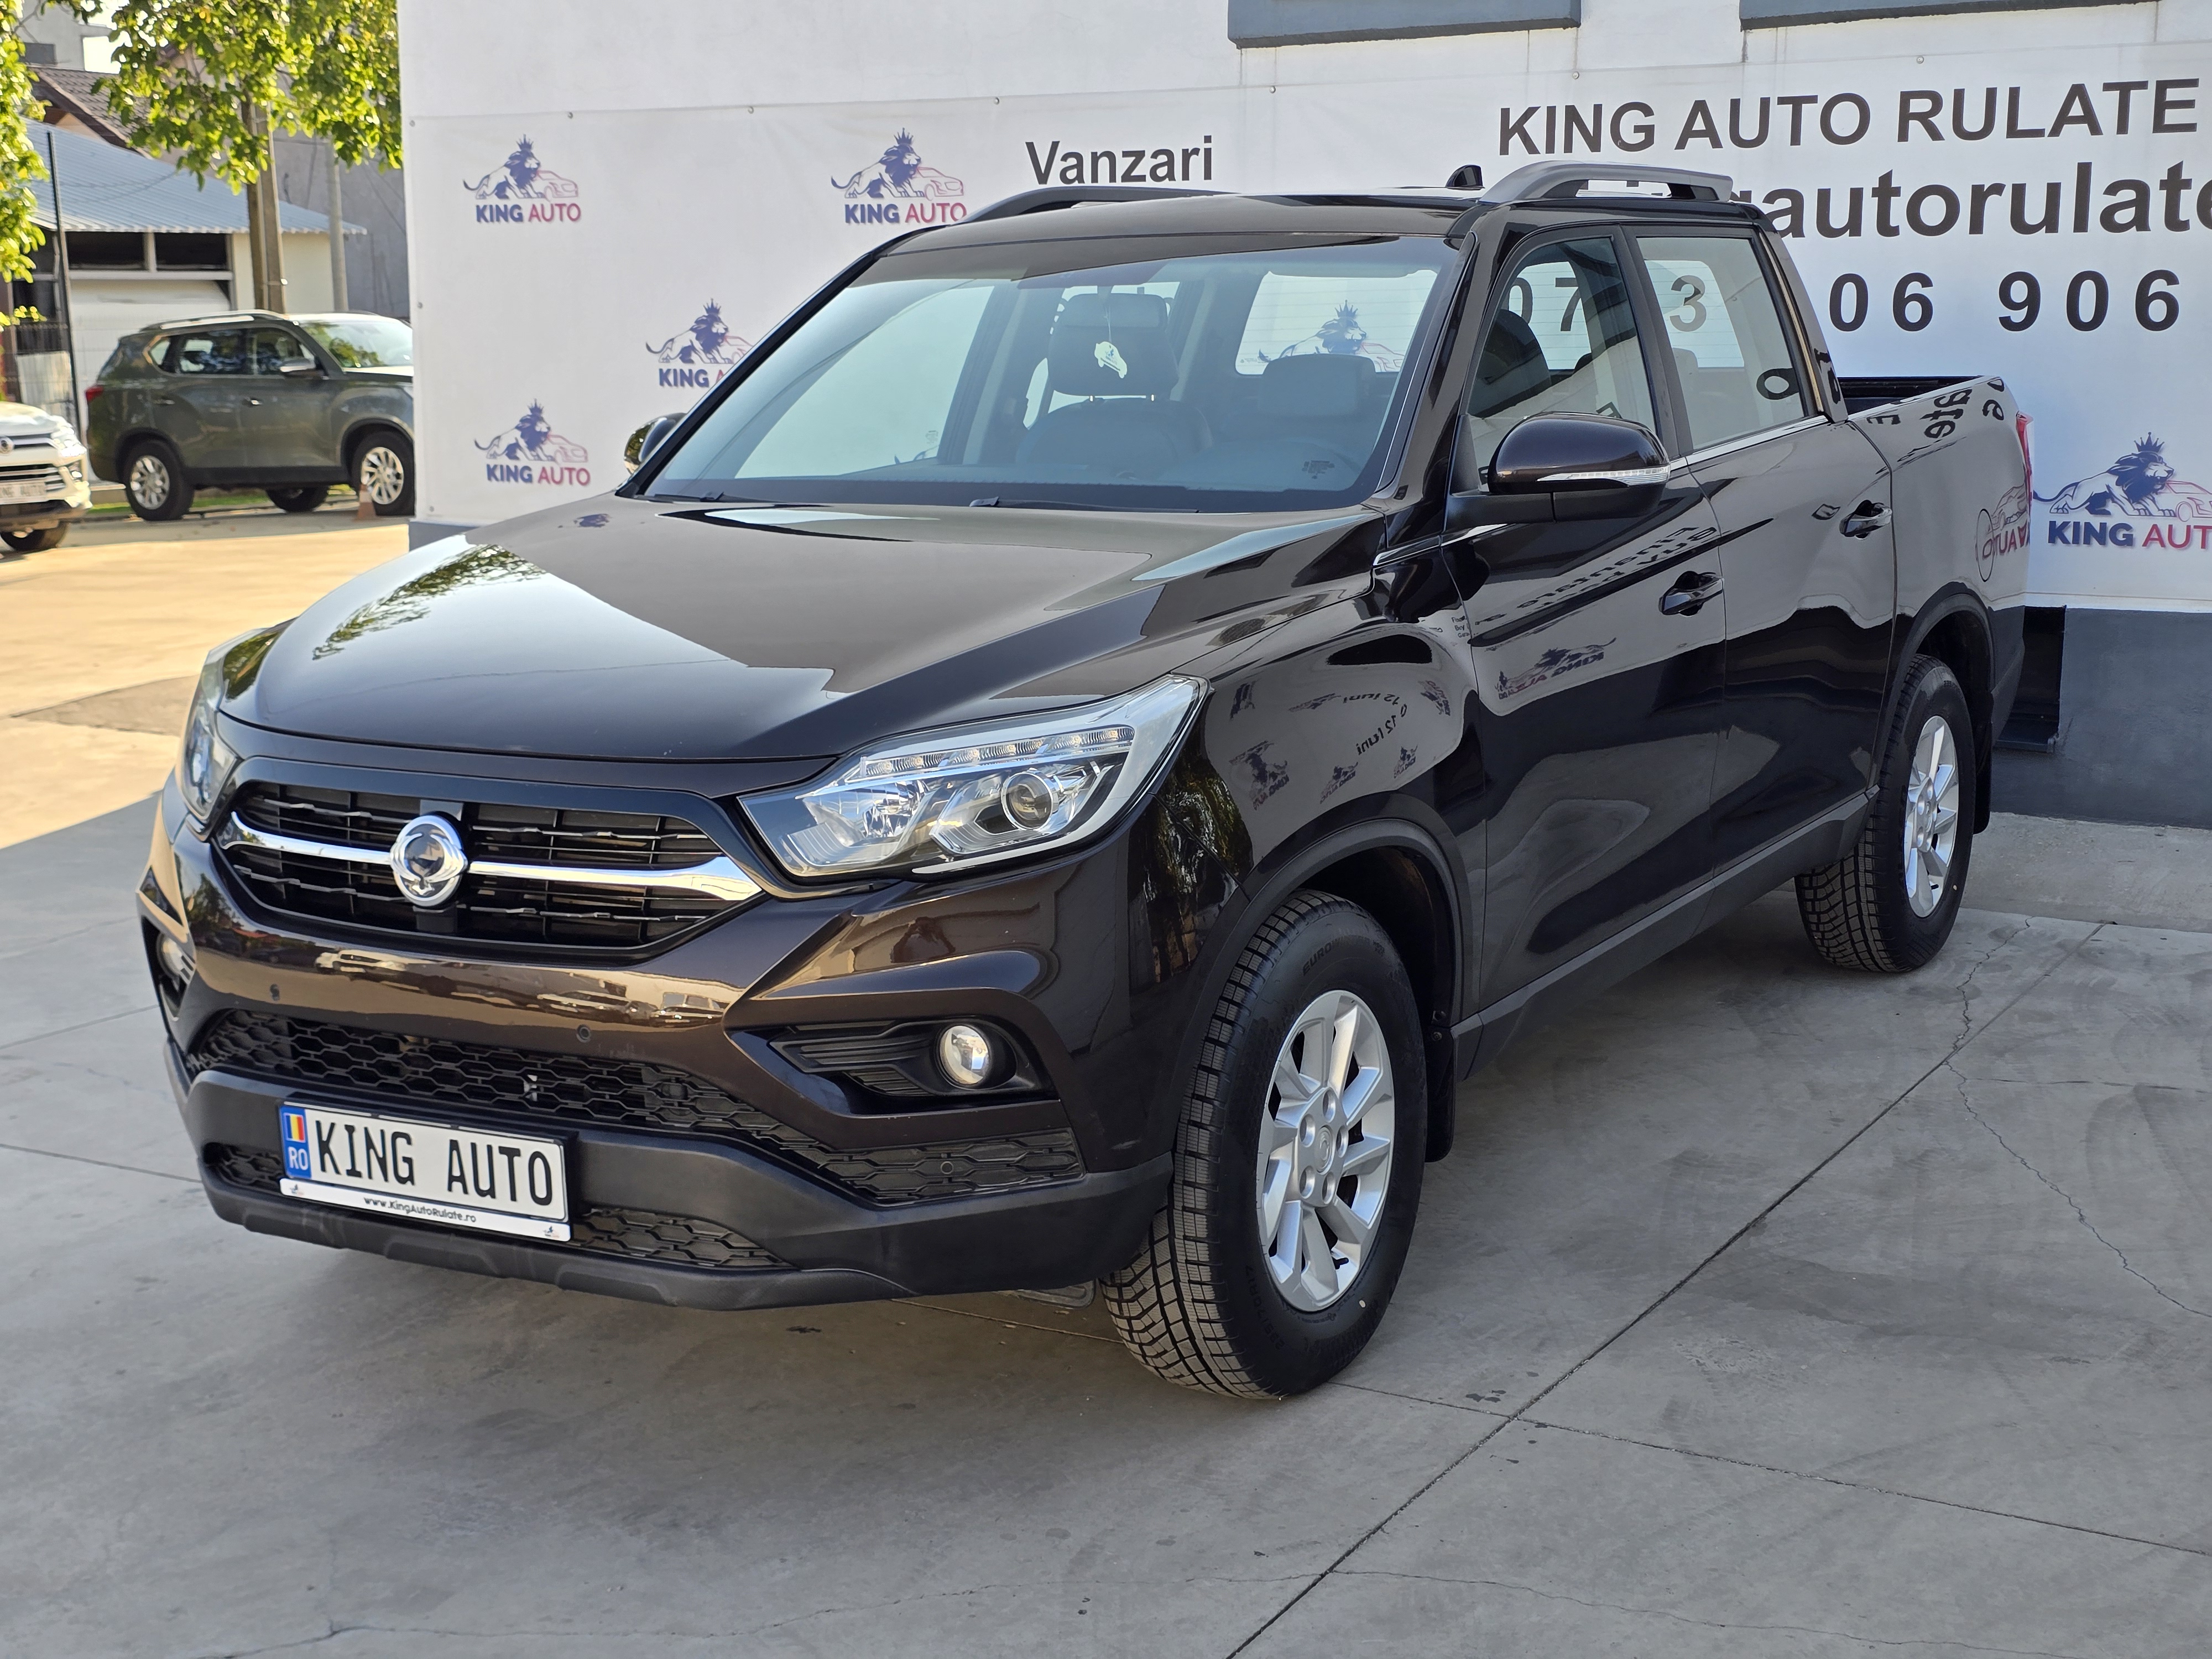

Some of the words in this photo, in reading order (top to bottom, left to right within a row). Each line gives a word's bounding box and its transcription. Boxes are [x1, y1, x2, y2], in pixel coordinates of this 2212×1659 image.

[1499, 102, 1655, 155] KING
[1674, 92, 1871, 150] AUTO
[1897, 78, 2200, 143] RULATE
[1025, 135, 1213, 185] Vanzari
[476, 204, 524, 223] KING
[528, 203, 581, 222] AUTO
[844, 203, 900, 223] KING
[905, 202, 967, 223] AUTO
[1998, 269, 2180, 331] 906
[659, 368, 709, 388] KING
[487, 463, 533, 483] KING
[538, 466, 591, 486] AUTO
[2048, 520, 2133, 546] KING
[2142, 523, 2212, 549] AUT
[288, 1146, 309, 1171] RO
[315, 1119, 416, 1186] KING
[447, 1139, 553, 1207] AUTO
[363, 1196, 477, 1223] www.KingAutoRulate.ro
